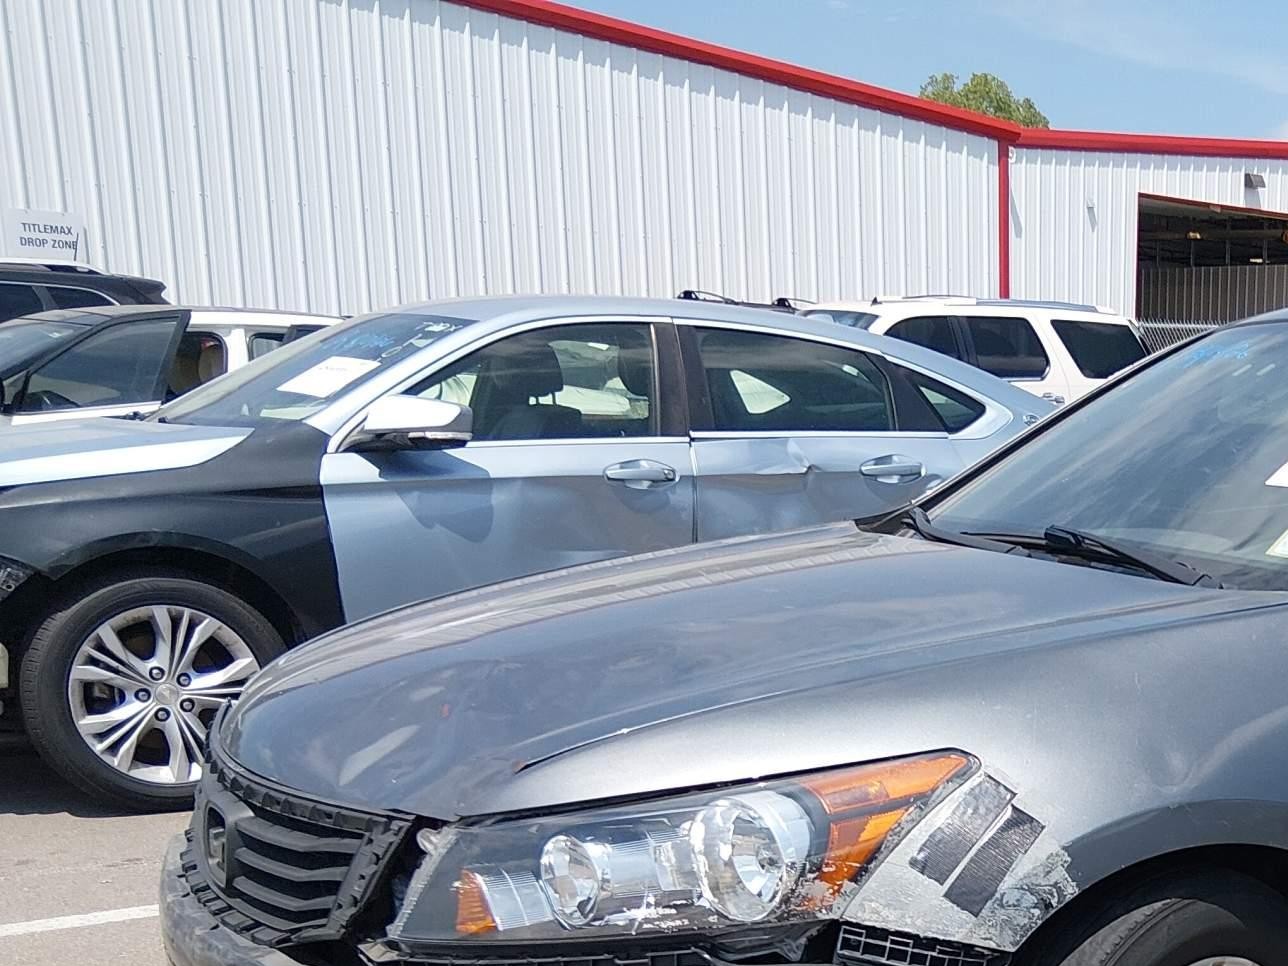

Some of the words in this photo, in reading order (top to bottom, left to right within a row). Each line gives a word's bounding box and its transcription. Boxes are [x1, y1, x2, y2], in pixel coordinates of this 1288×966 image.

[21, 222, 74, 236] TITLEMAX
[19, 236, 49, 248] DROP
[51, 239, 78, 250] ZONE
